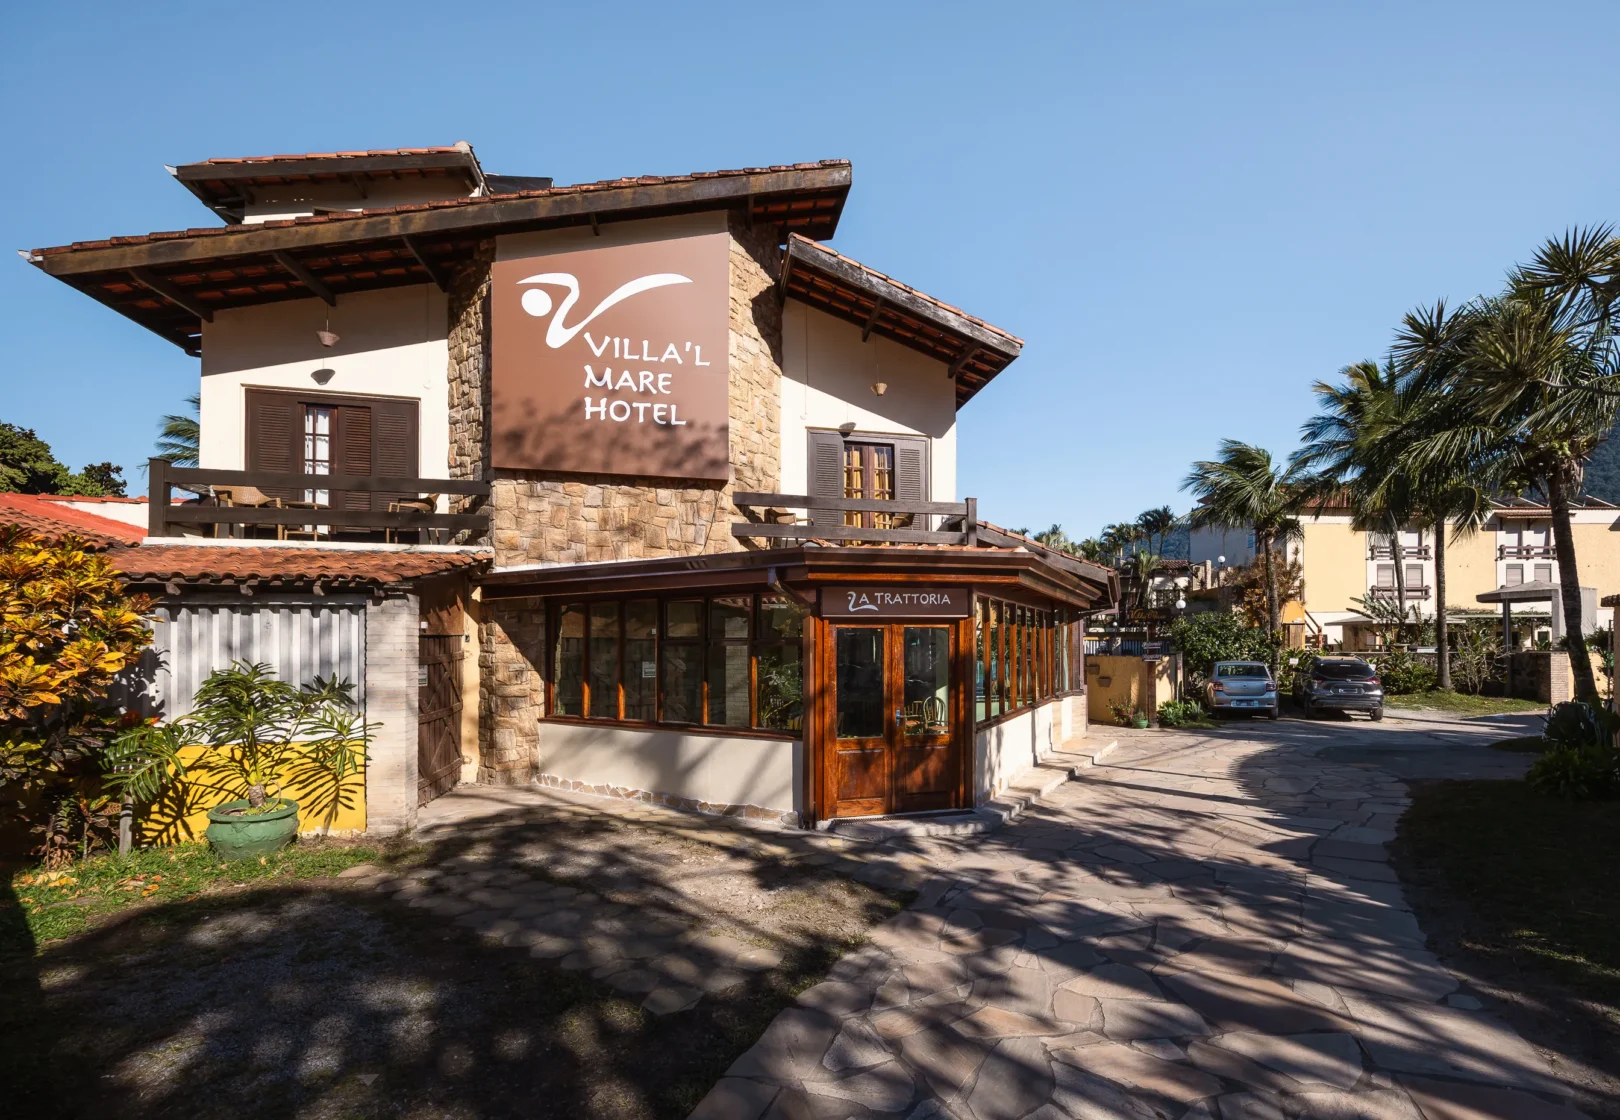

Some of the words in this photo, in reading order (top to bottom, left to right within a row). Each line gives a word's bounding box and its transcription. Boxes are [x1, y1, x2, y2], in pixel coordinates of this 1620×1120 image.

[583, 332, 711, 367] VILLA'L
[583, 364, 673, 395] MARE
[583, 396, 687, 426] HOTEL
[874, 592, 951, 605] TRATTORIA
